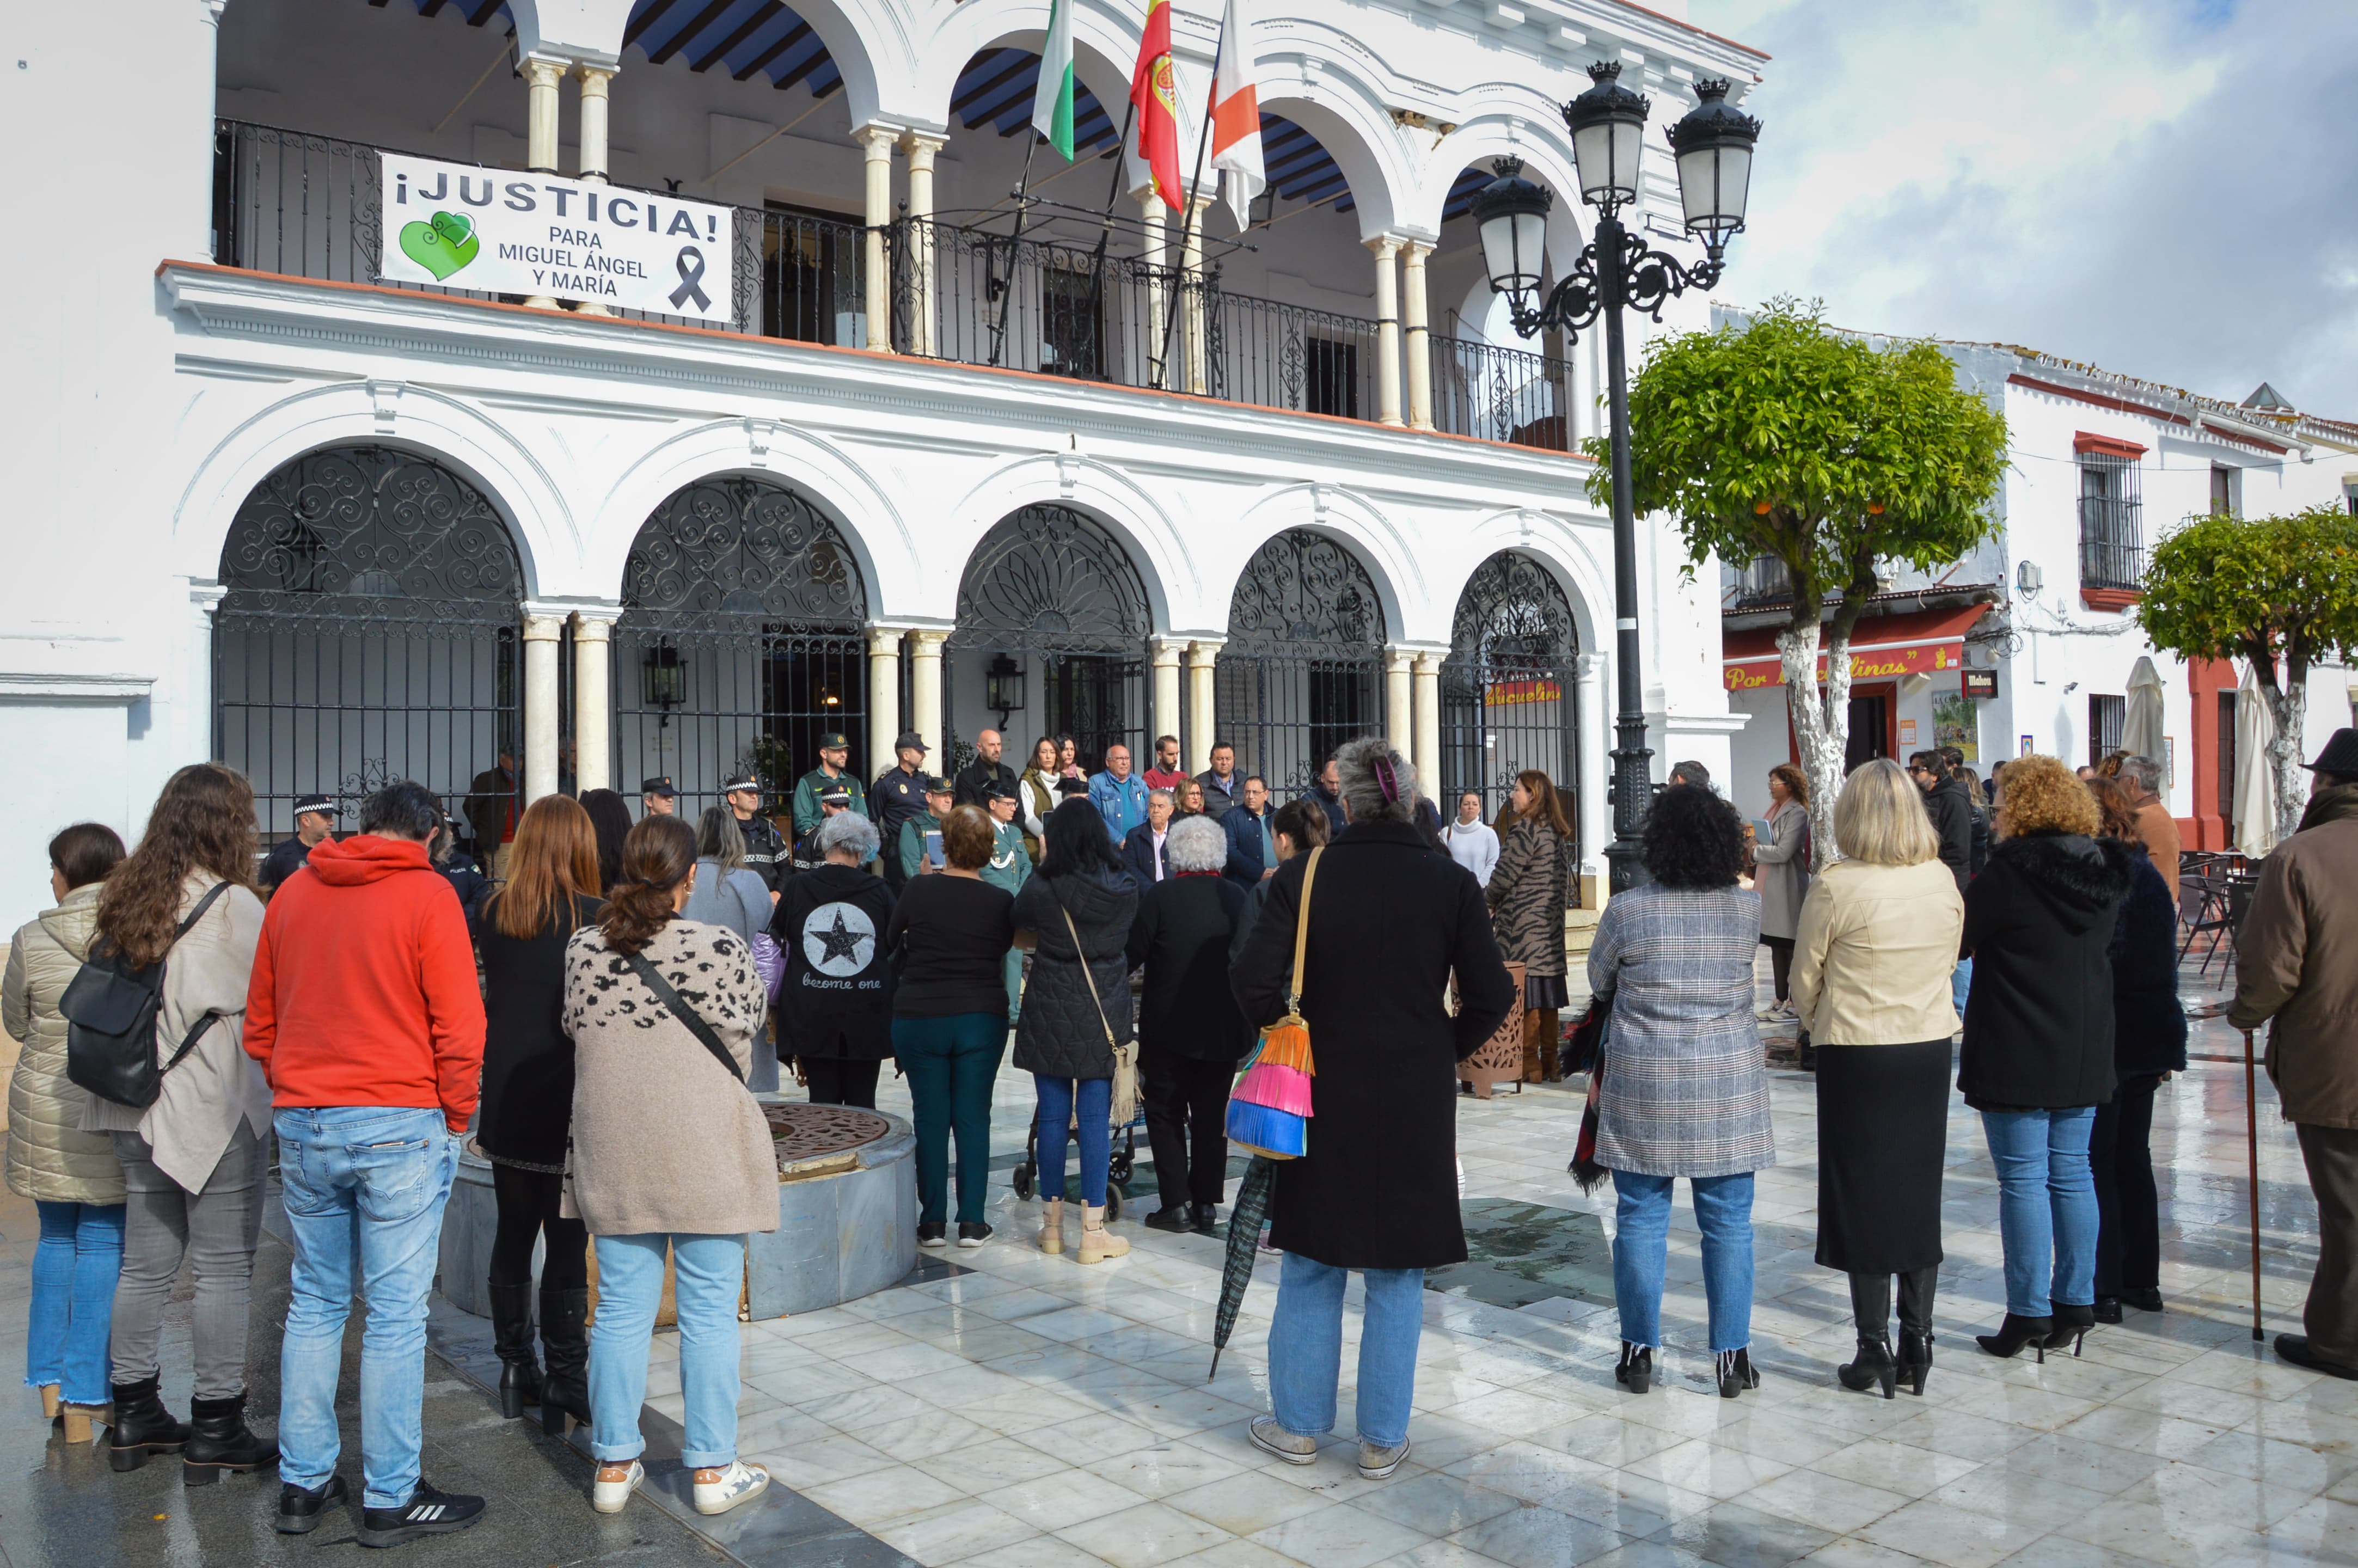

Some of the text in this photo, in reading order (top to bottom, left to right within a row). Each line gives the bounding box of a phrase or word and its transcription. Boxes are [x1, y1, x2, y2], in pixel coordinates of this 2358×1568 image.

[396, 173, 716, 243] ¡JUSTICIA!
[550, 226, 602, 249] PARA
[499, 243, 647, 279] MIGUEL ÁNGEL
[532, 269, 617, 297] Y MARÍA
[1725, 668, 1767, 689] Por
[1968, 675, 1992, 686] Mahou
[803, 972, 881, 989] become one
